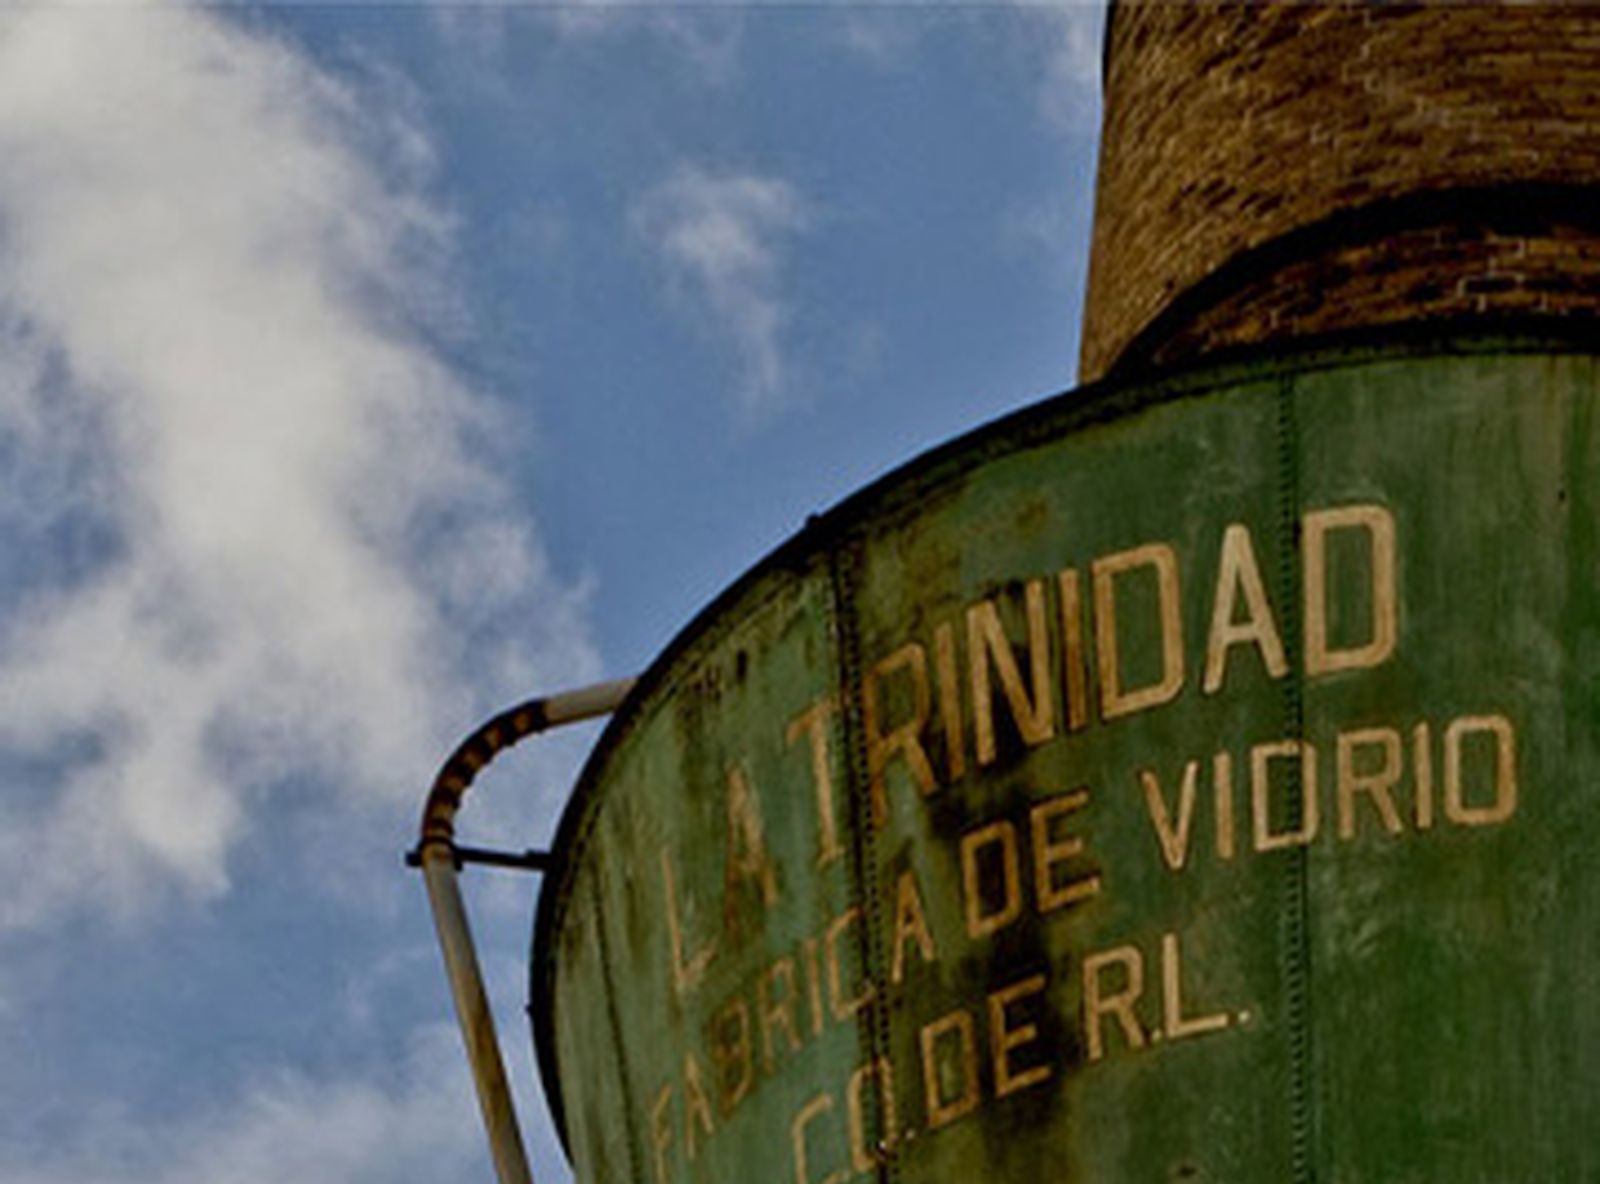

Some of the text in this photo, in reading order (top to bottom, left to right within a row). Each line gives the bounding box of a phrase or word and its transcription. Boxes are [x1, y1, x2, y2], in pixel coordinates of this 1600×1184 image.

[660, 504, 1398, 993] LA TRINIDAD
[959, 788, 1101, 940] DE
[1140, 713, 1517, 870] VIDRIO
[921, 974, 1051, 1130] DE
[1082, 932, 1250, 1061] R.L.
